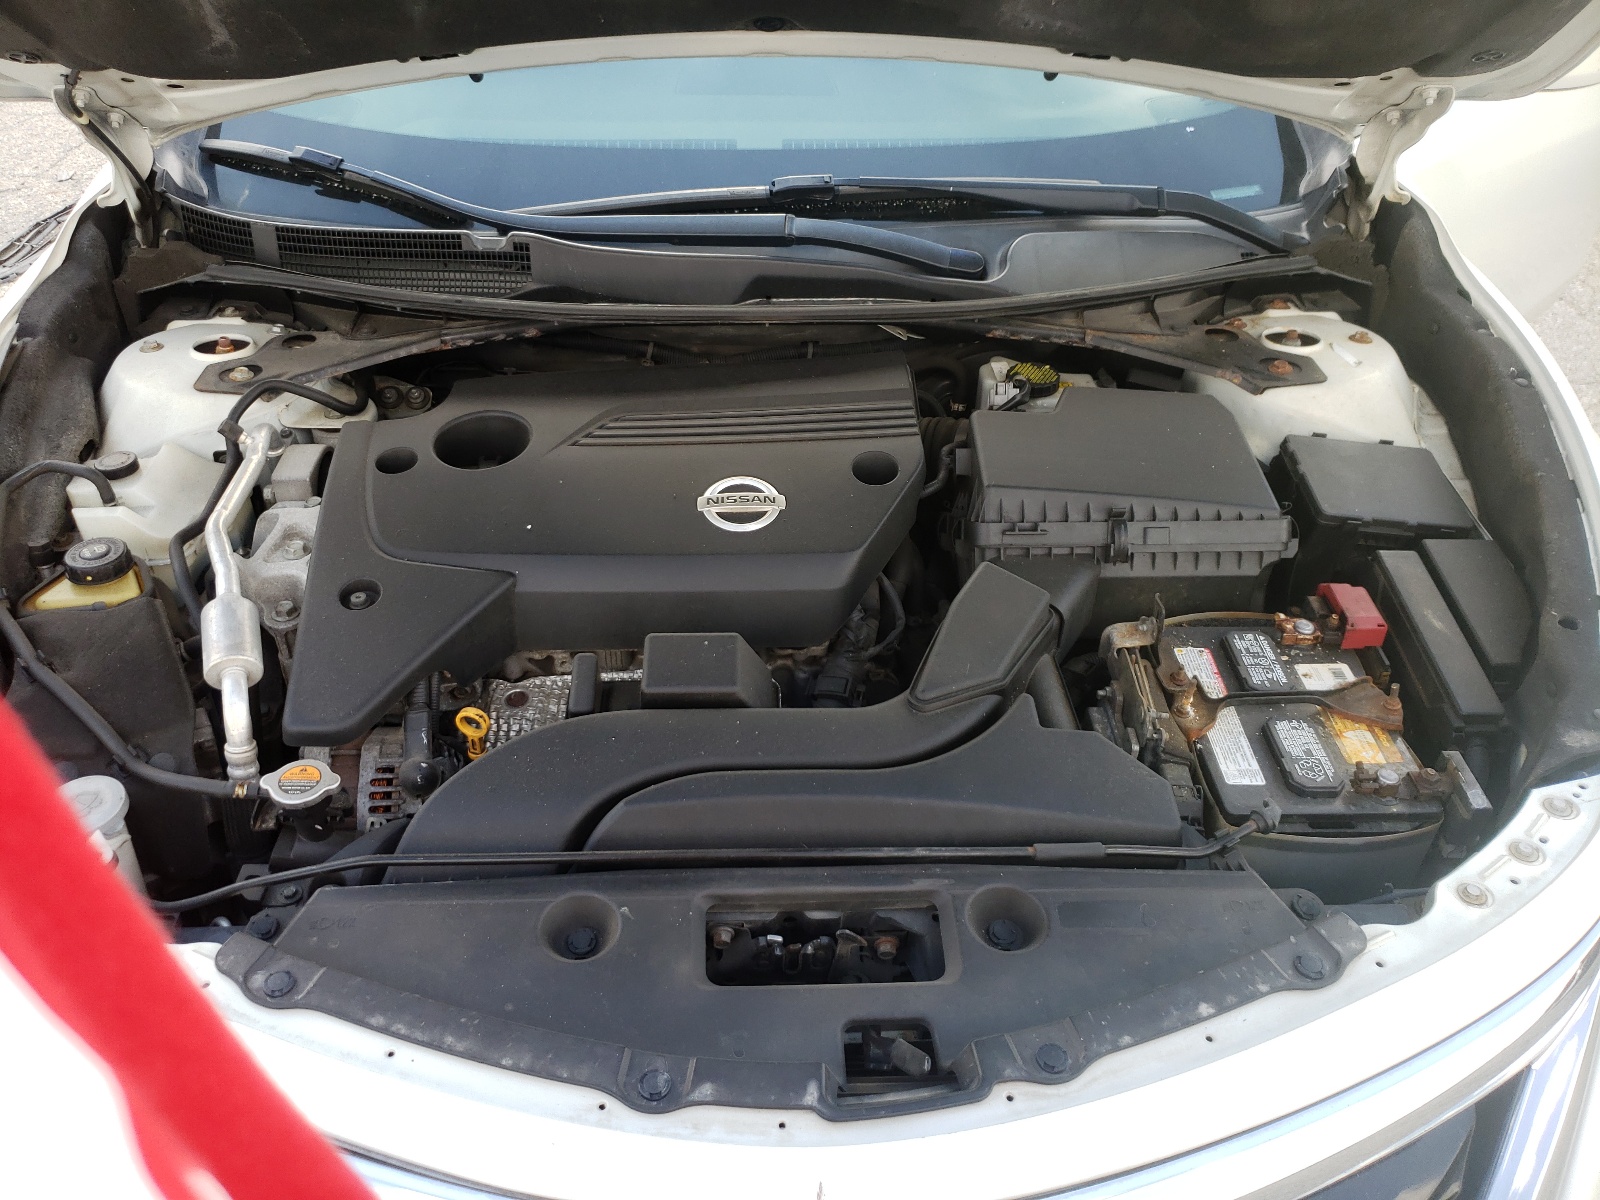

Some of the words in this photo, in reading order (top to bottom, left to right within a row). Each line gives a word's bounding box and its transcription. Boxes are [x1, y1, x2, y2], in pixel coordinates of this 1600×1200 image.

[706, 495, 776, 506] NISSAN
[1262, 640, 1276, 660] DANGER
[1274, 664, 1288, 683] POISON
